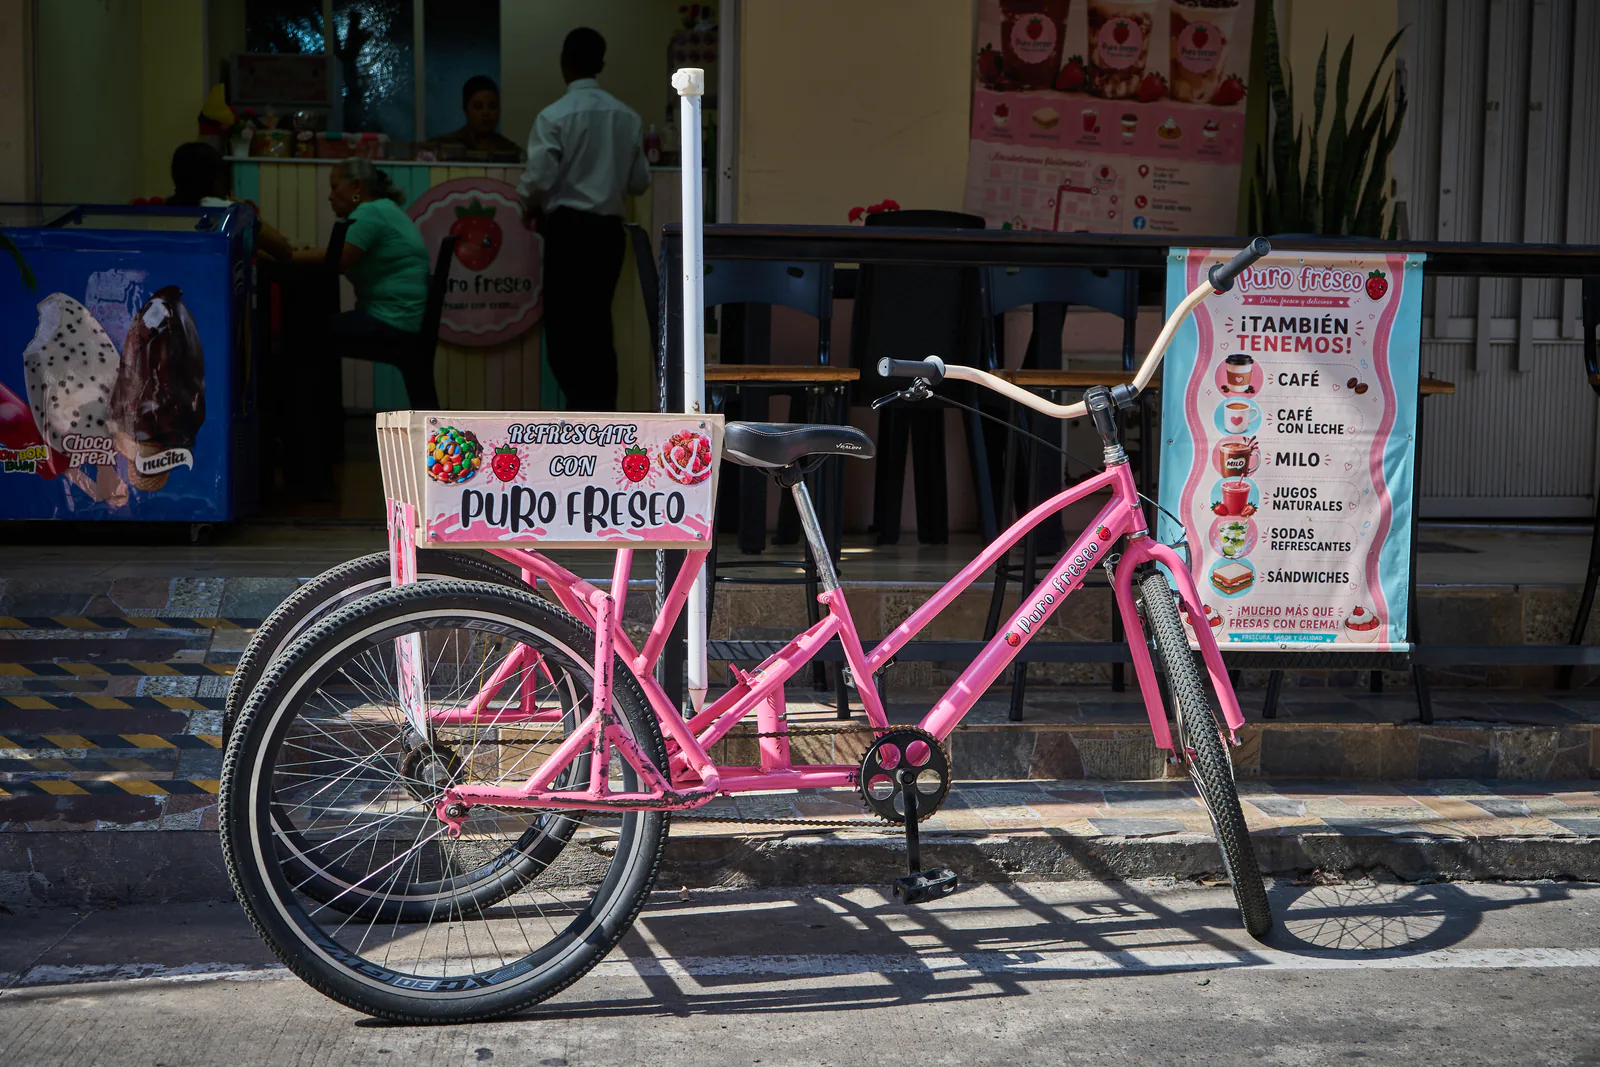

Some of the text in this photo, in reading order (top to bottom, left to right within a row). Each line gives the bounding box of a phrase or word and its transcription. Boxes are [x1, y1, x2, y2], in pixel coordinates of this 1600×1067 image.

[1239, 265, 1294, 292] Puro
[1241, 314, 1349, 335] ¡TAMBIÉN
[1236, 334, 1352, 354] TENEMOS!
[1278, 370, 1320, 387] CAFÉ
[1277, 407, 1313, 421] CAFÉ
[507, 422, 638, 447] REFRESCATE
[1277, 423, 1345, 435] CON LECHE
[63, 434, 113, 452] Choco
[0, 449, 17, 461] ON
[142, 450, 187, 471] nucita
[1275, 452, 1320, 467] MILO
[549, 455, 597, 477] CON
[1272, 487, 1318, 499] JUGOS
[461, 485, 558, 534] PURO
[1272, 500, 1343, 512] NATURALES
[1271, 528, 1315, 540] SODAS
[1271, 541, 1351, 552] REFRESCANTES
[1267, 568, 1350, 584] SÁNDWICHES
[1016, 593, 1055, 634] Puro
[1237, 604, 1334, 617] ¡MUCHO MÁS QUE
[1229, 618, 1339, 629] FRESAS CON CREMA!
